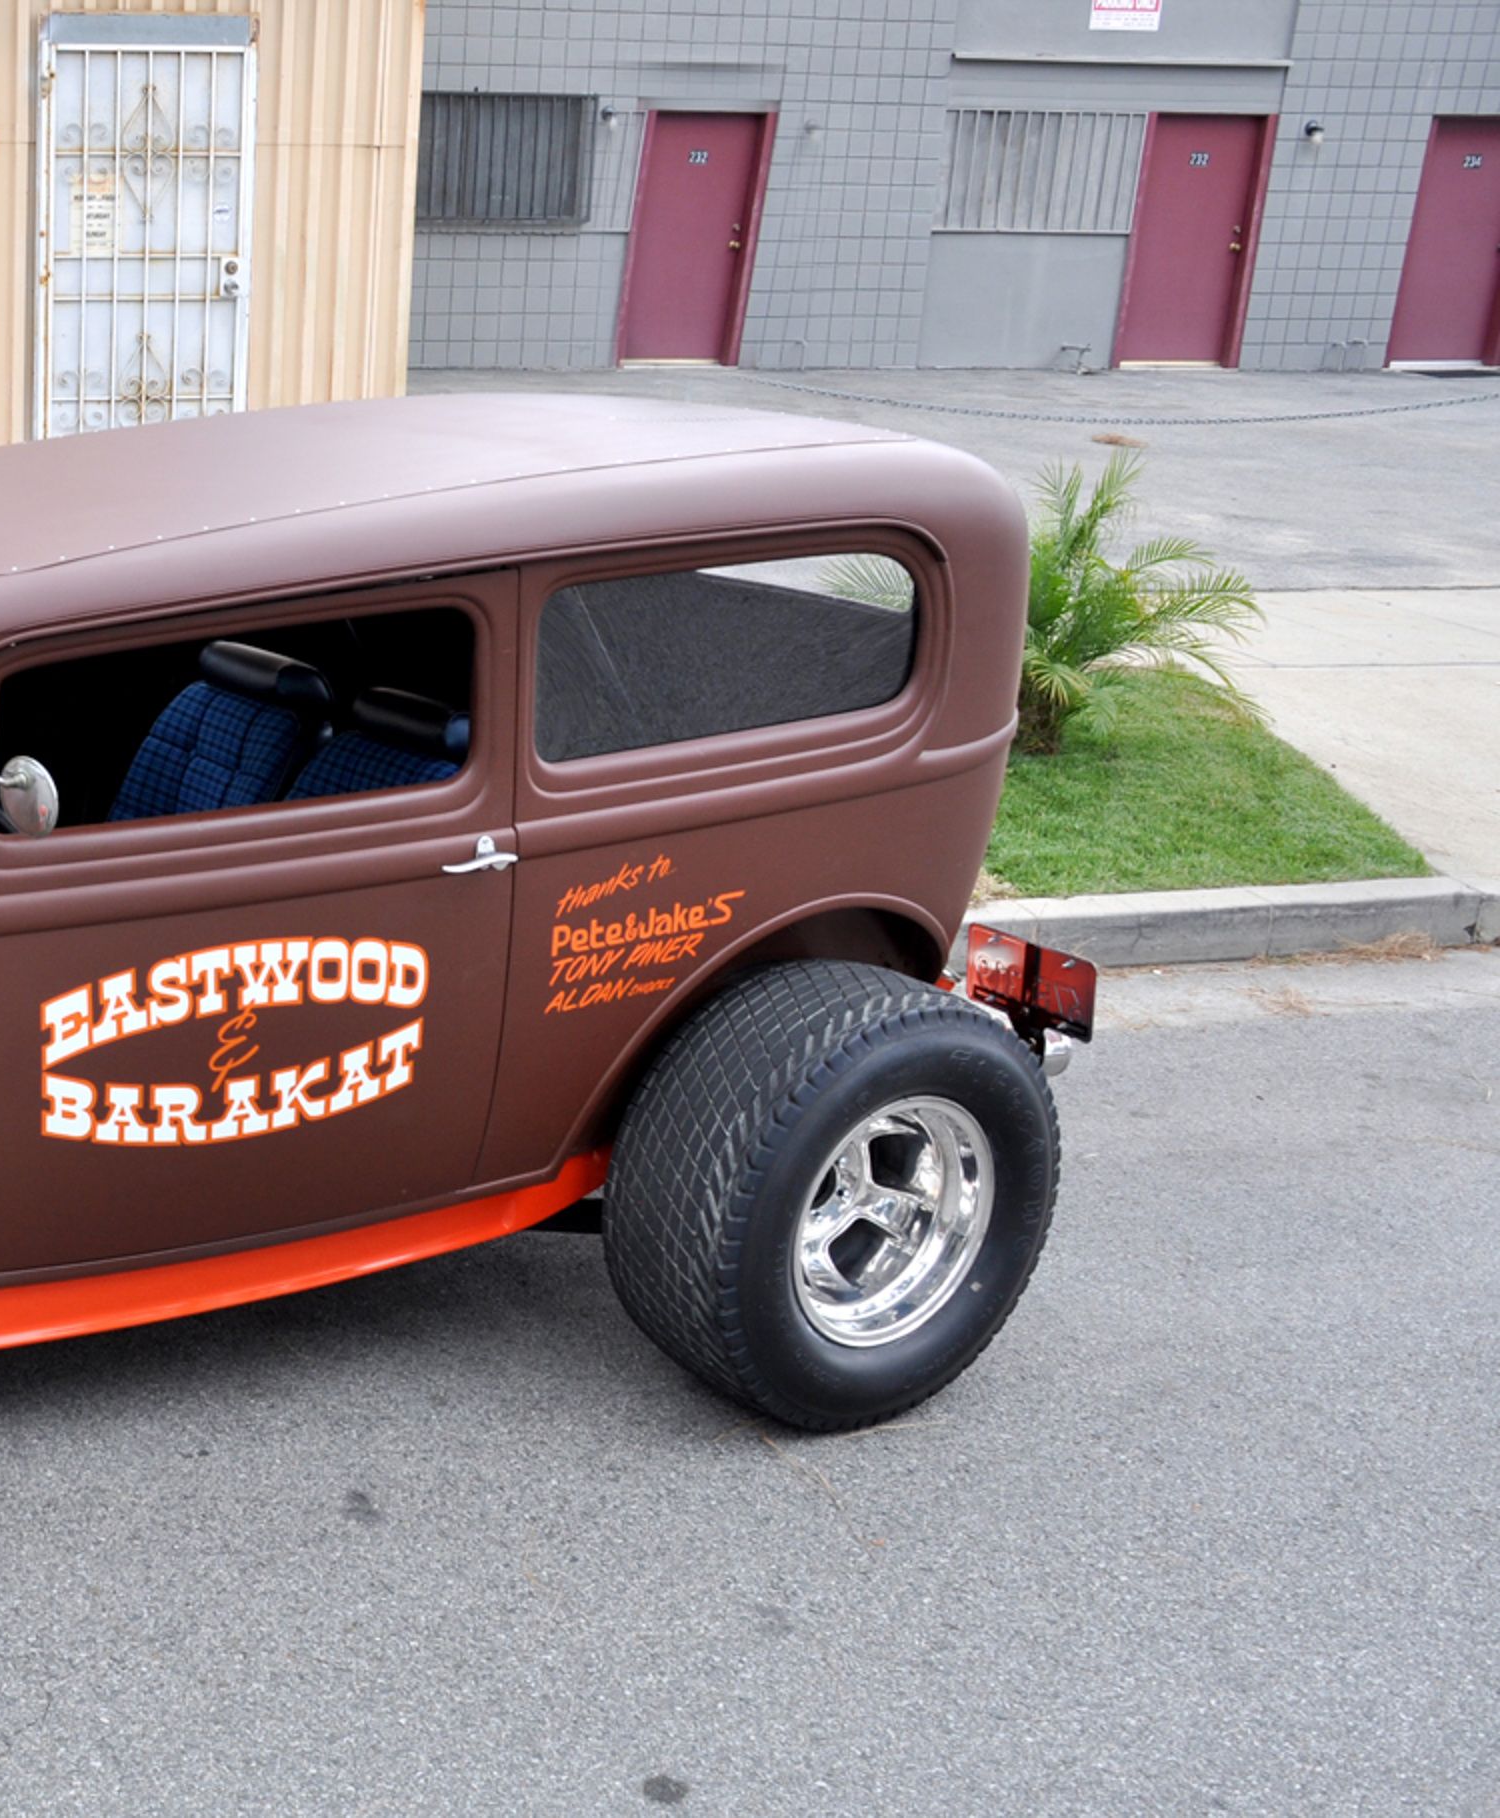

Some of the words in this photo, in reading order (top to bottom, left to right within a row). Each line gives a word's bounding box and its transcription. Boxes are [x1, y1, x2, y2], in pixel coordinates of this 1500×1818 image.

[688, 151, 708, 164] 232
[556, 863, 644, 918] thanks
[549, 947, 624, 986] TONY
[622, 933, 704, 970] PINER
[40, 935, 429, 1071] EASTWOOD
[544, 977, 634, 1014] ALDAN
[208, 999, 259, 1093] &
[40, 1017, 424, 1147] BARAKAT
